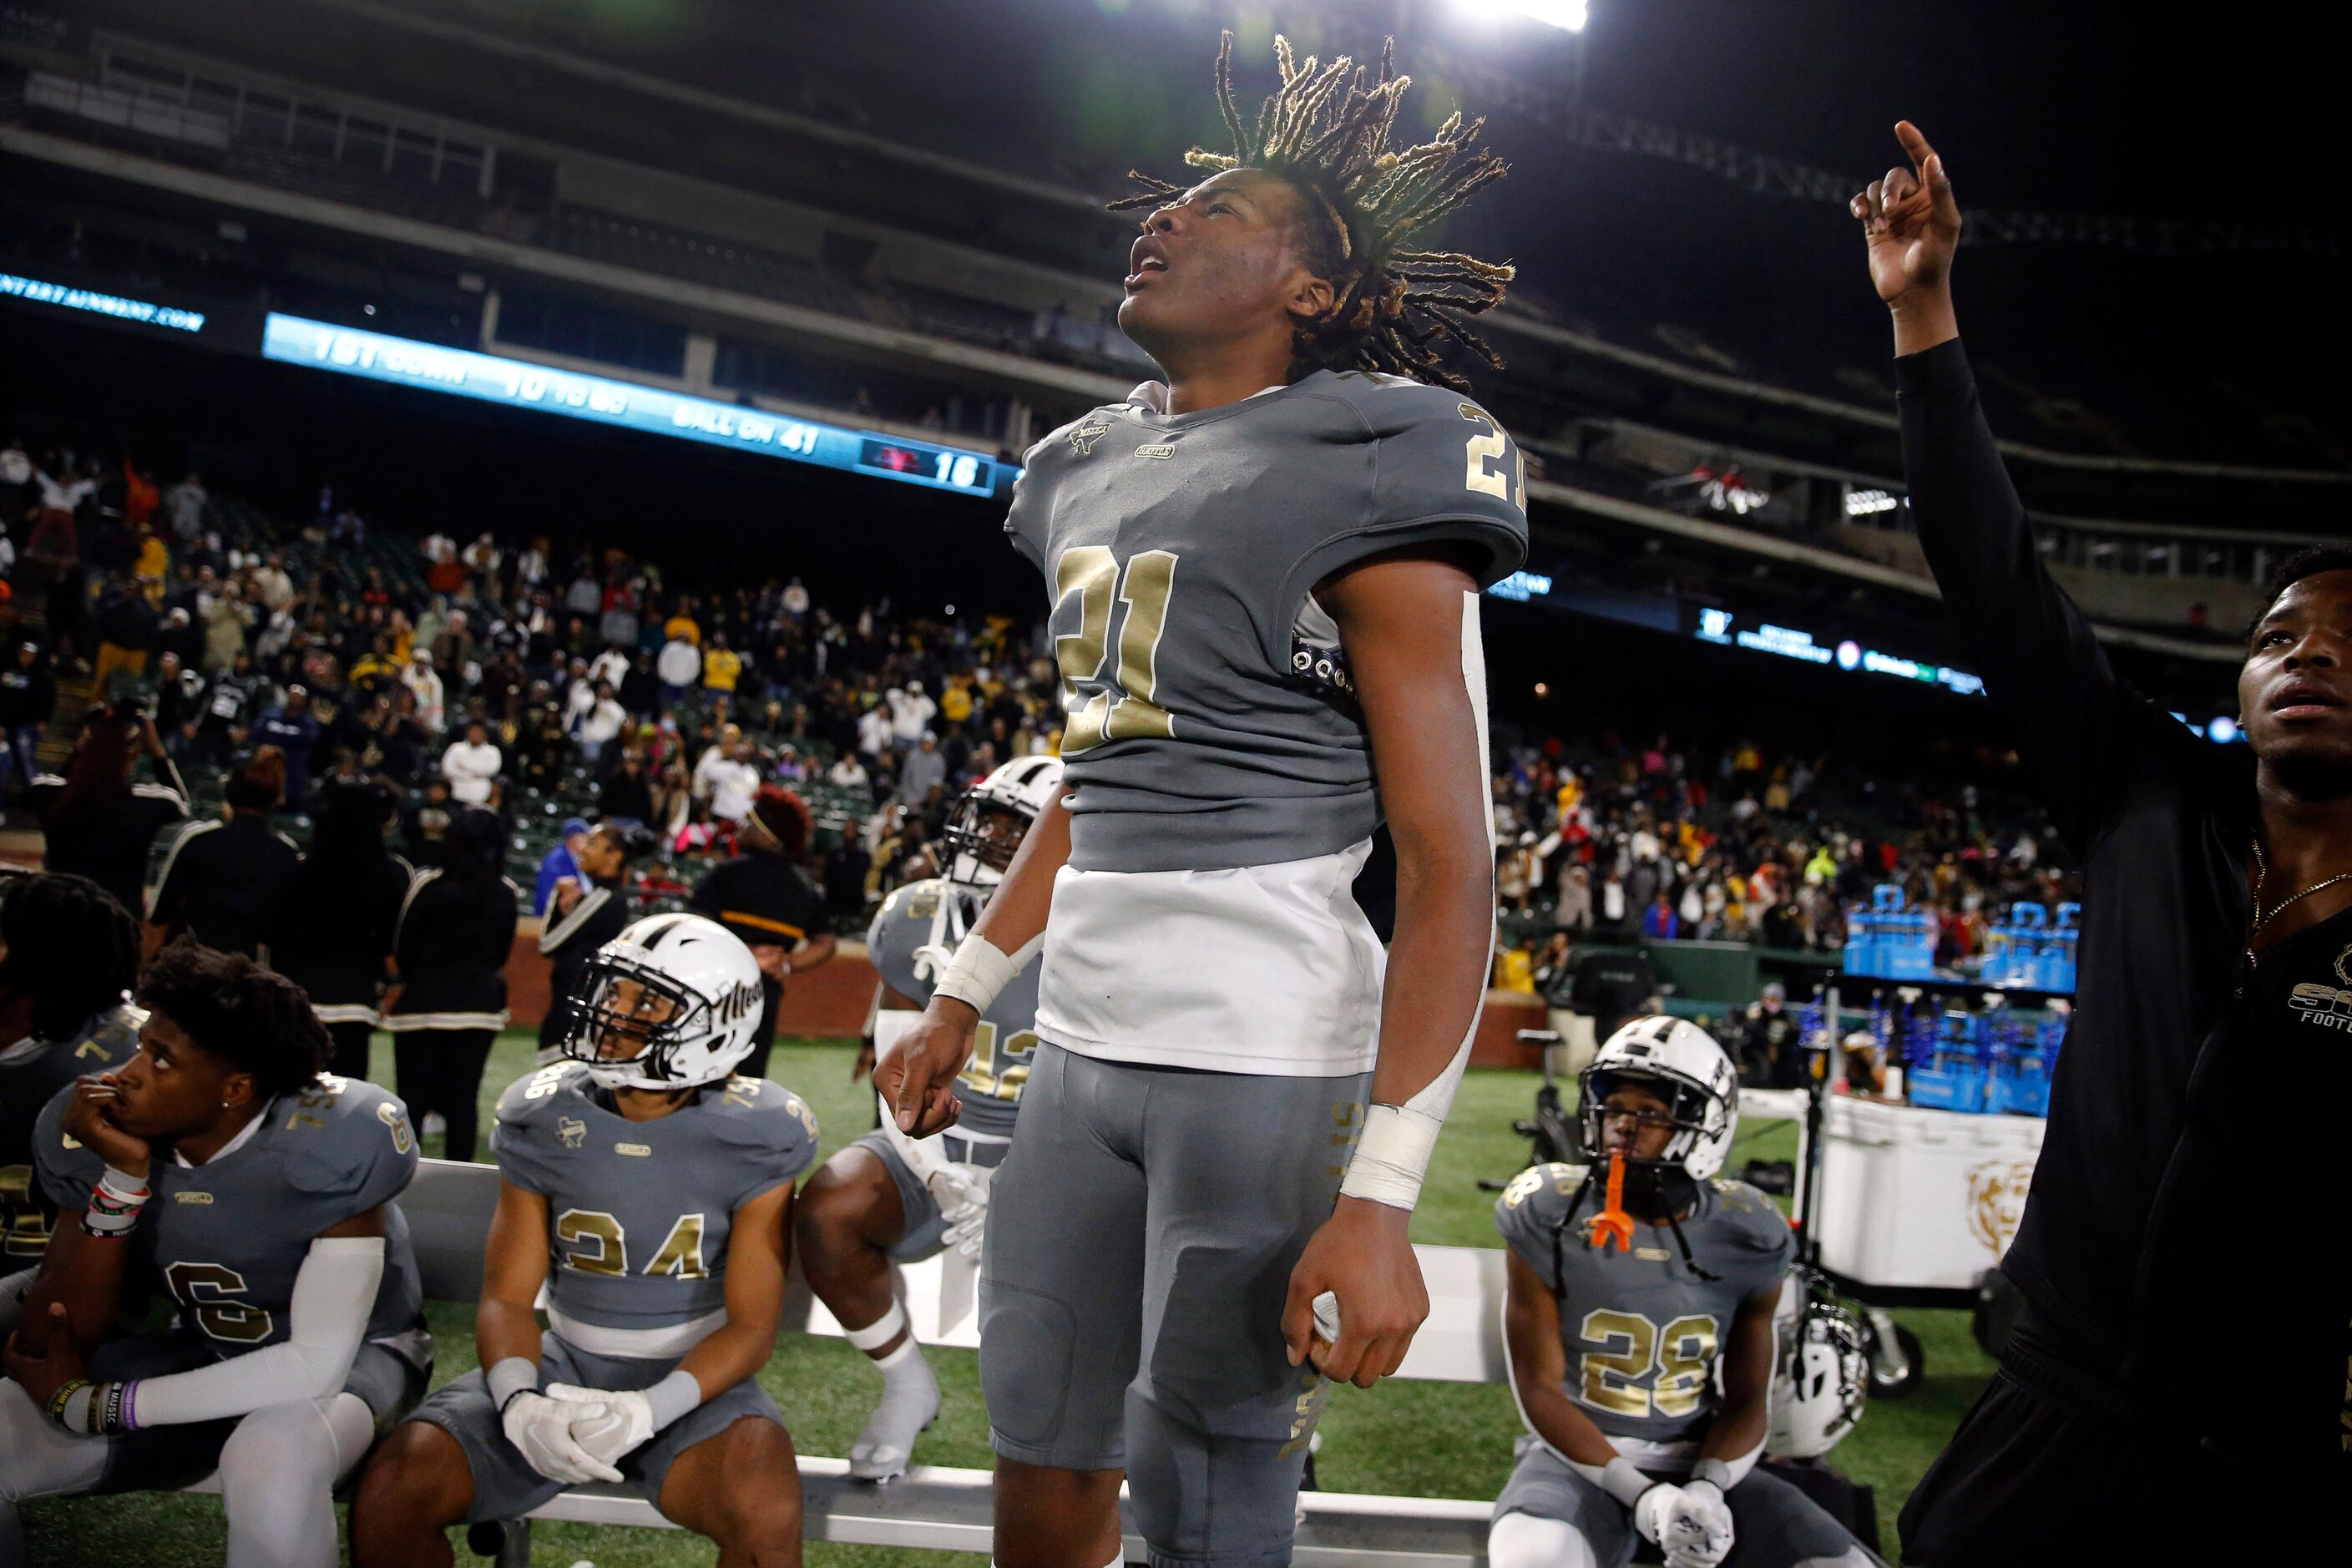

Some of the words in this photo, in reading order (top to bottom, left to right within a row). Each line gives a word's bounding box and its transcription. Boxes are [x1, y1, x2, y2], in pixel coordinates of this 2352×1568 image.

[504, 367, 548, 402] 10
[672, 403, 735, 437] BALL
[738, 417, 775, 444] ON
[778, 422, 819, 455] 41
[1136, 446, 1172, 457] BATTLE
[935, 452, 979, 488] 16
[1055, 545, 1180, 756] 21
[377, 1101, 414, 1155] 6
[165, 1261, 273, 1343] 6
[1580, 1308, 1720, 1418] 28
